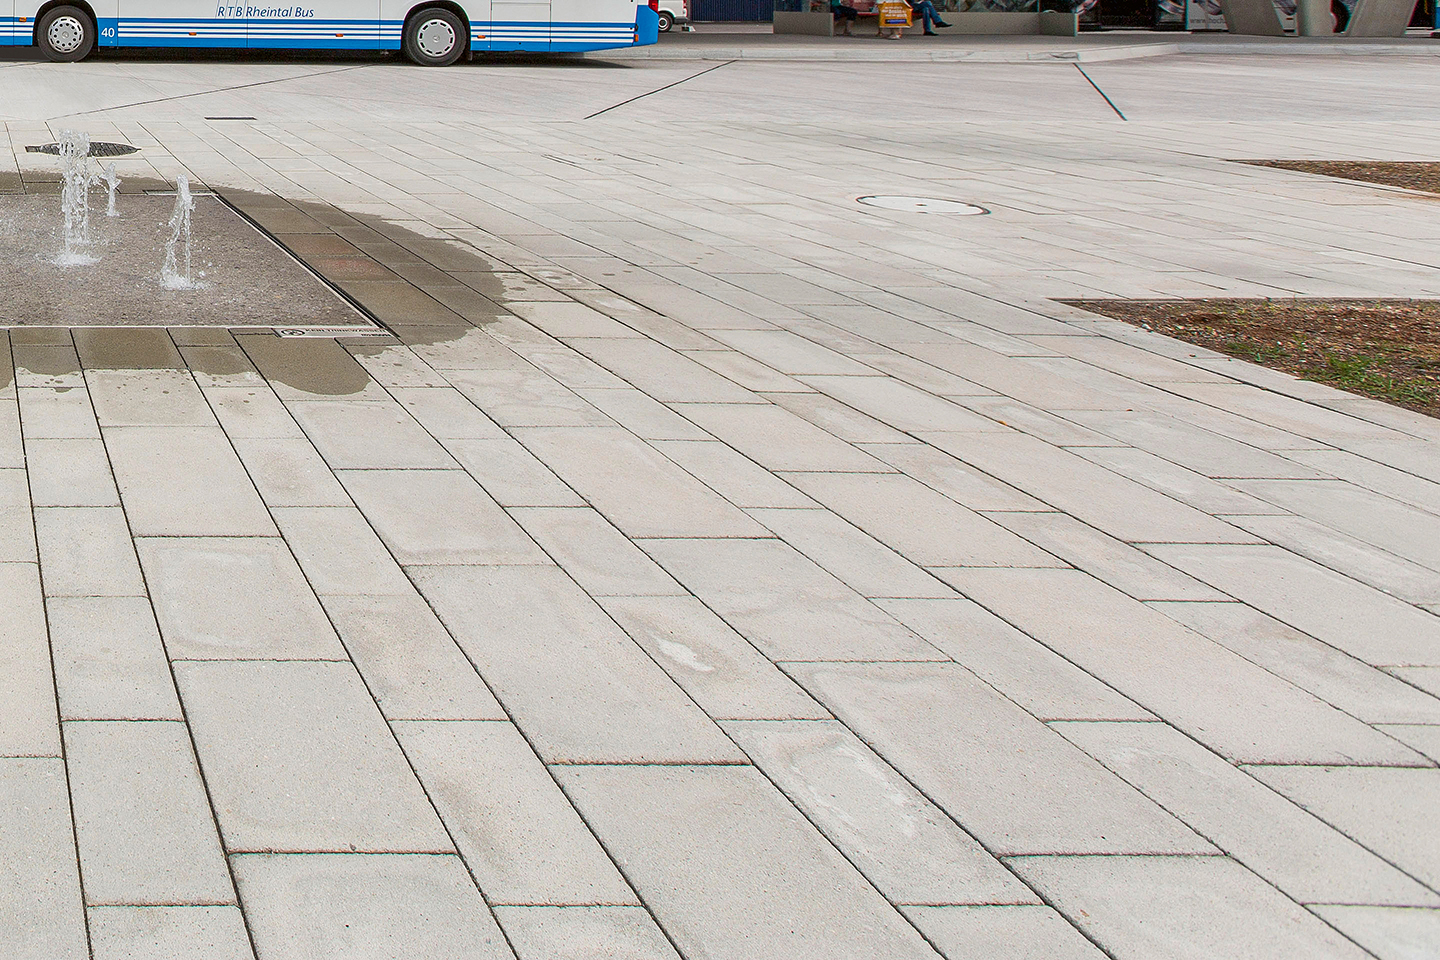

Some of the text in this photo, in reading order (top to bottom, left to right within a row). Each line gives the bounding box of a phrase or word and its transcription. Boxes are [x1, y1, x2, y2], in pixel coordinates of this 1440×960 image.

[245, 5, 293, 17] Rheintal
[294, 6, 315, 17] Bus
[101, 27, 115, 38] 40
